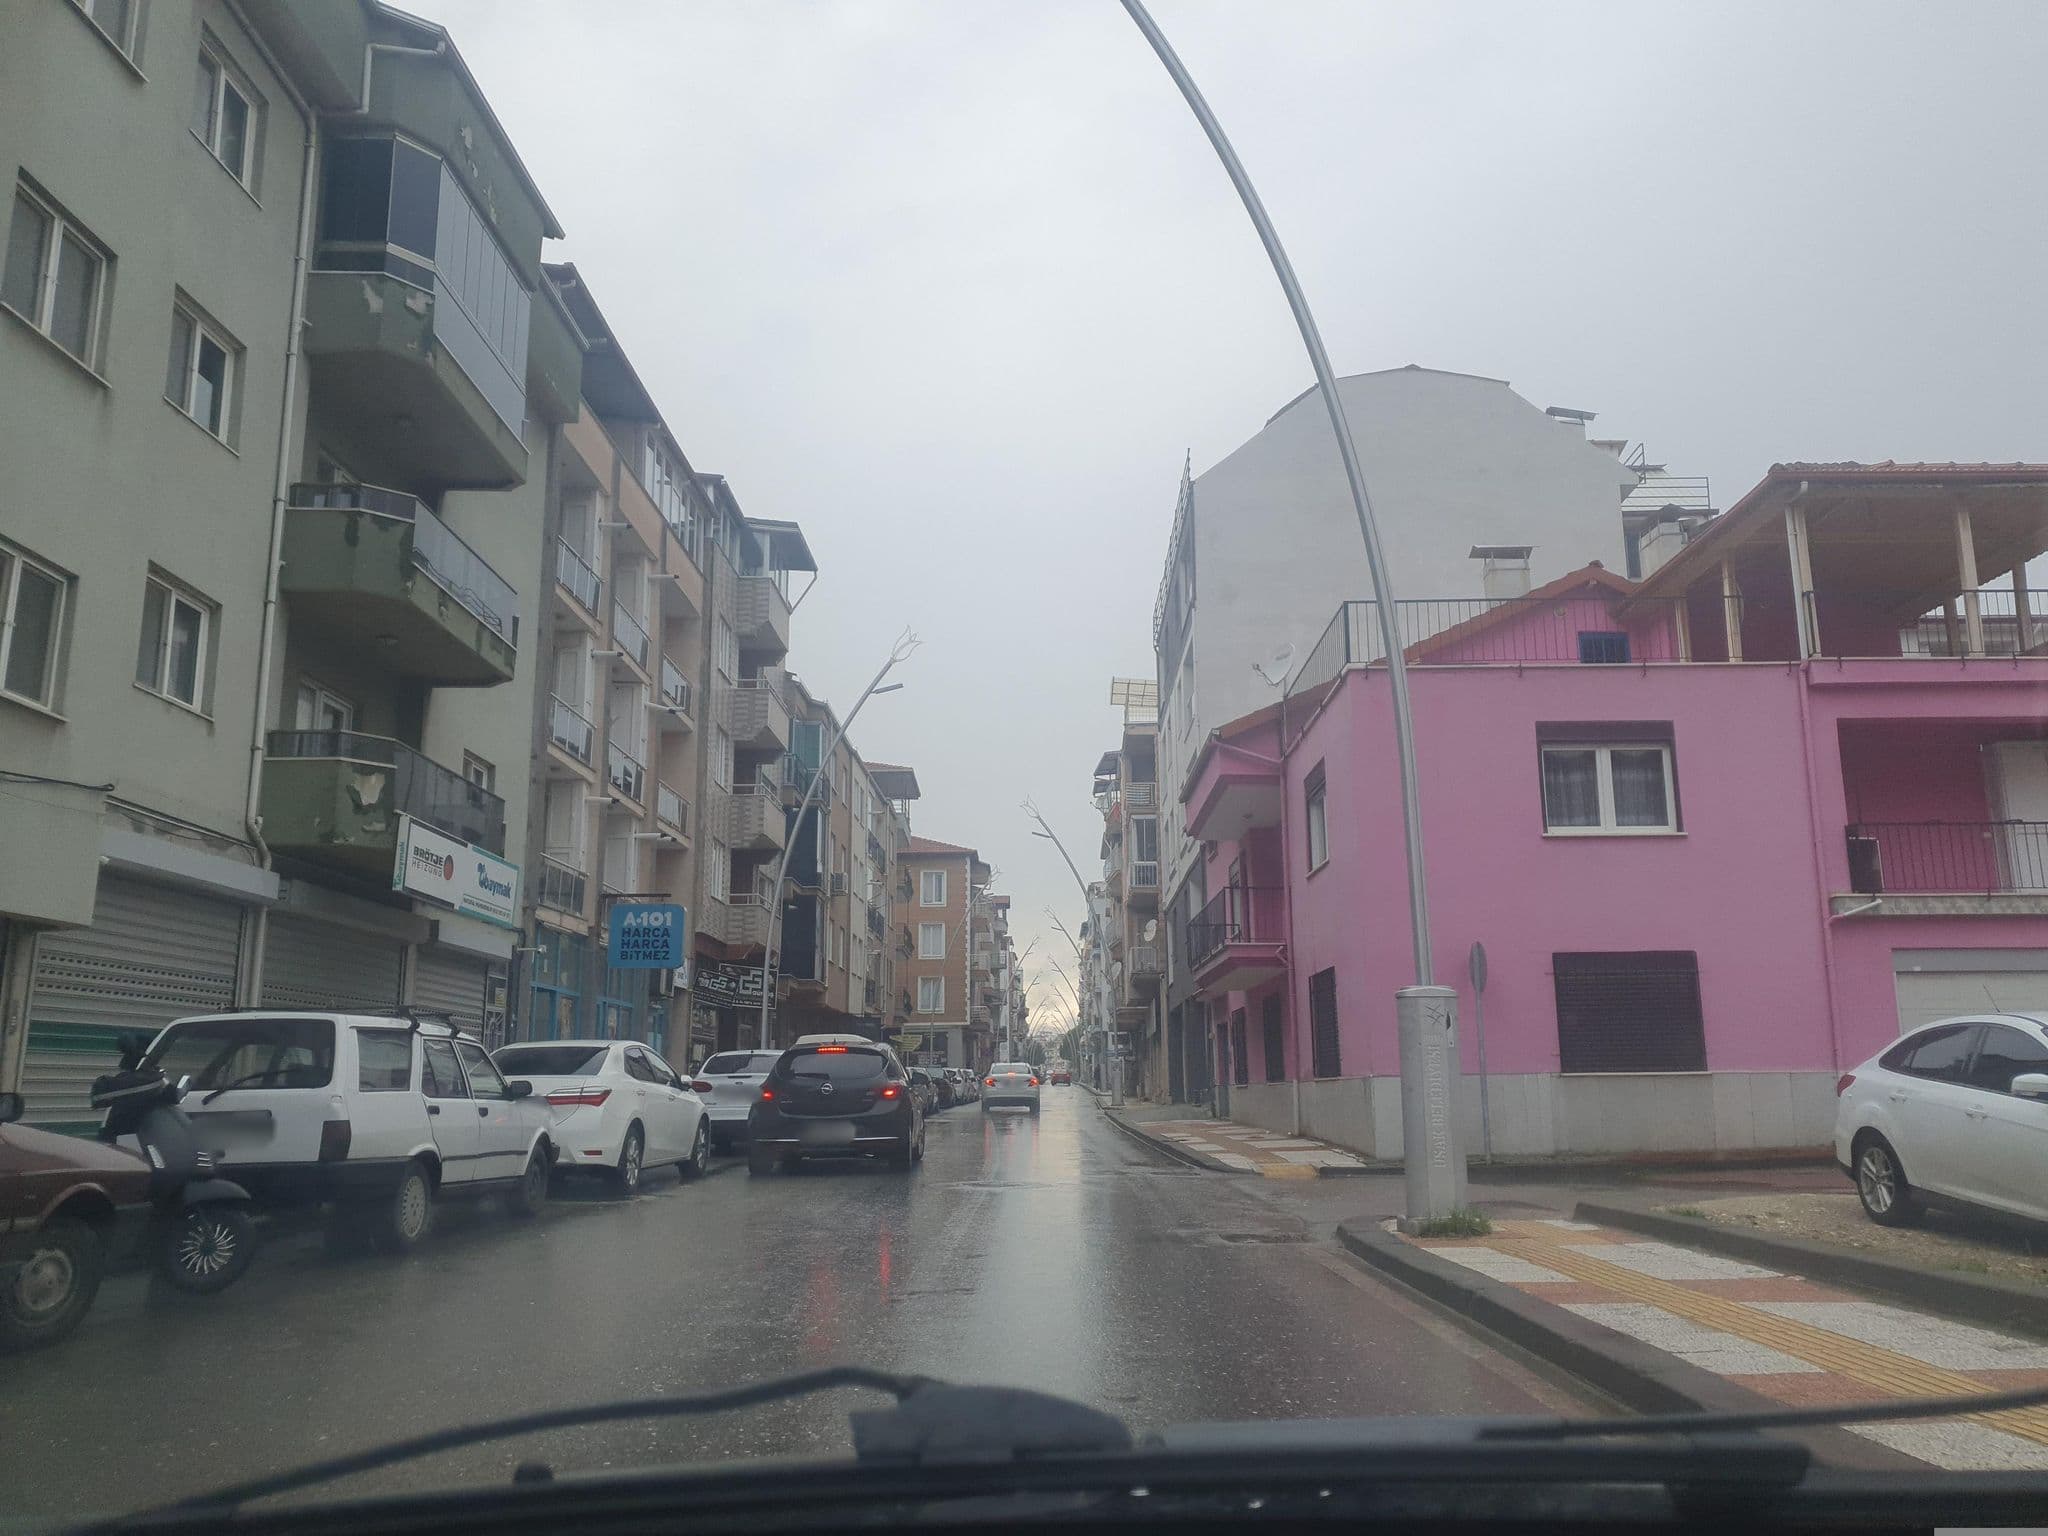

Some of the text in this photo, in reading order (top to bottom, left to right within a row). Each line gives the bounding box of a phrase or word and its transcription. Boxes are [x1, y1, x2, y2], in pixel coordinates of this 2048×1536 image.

[413, 845, 445, 867] BRÖTJE
[621, 927, 671, 938] HARCA
[620, 939, 670, 949] HARCA
